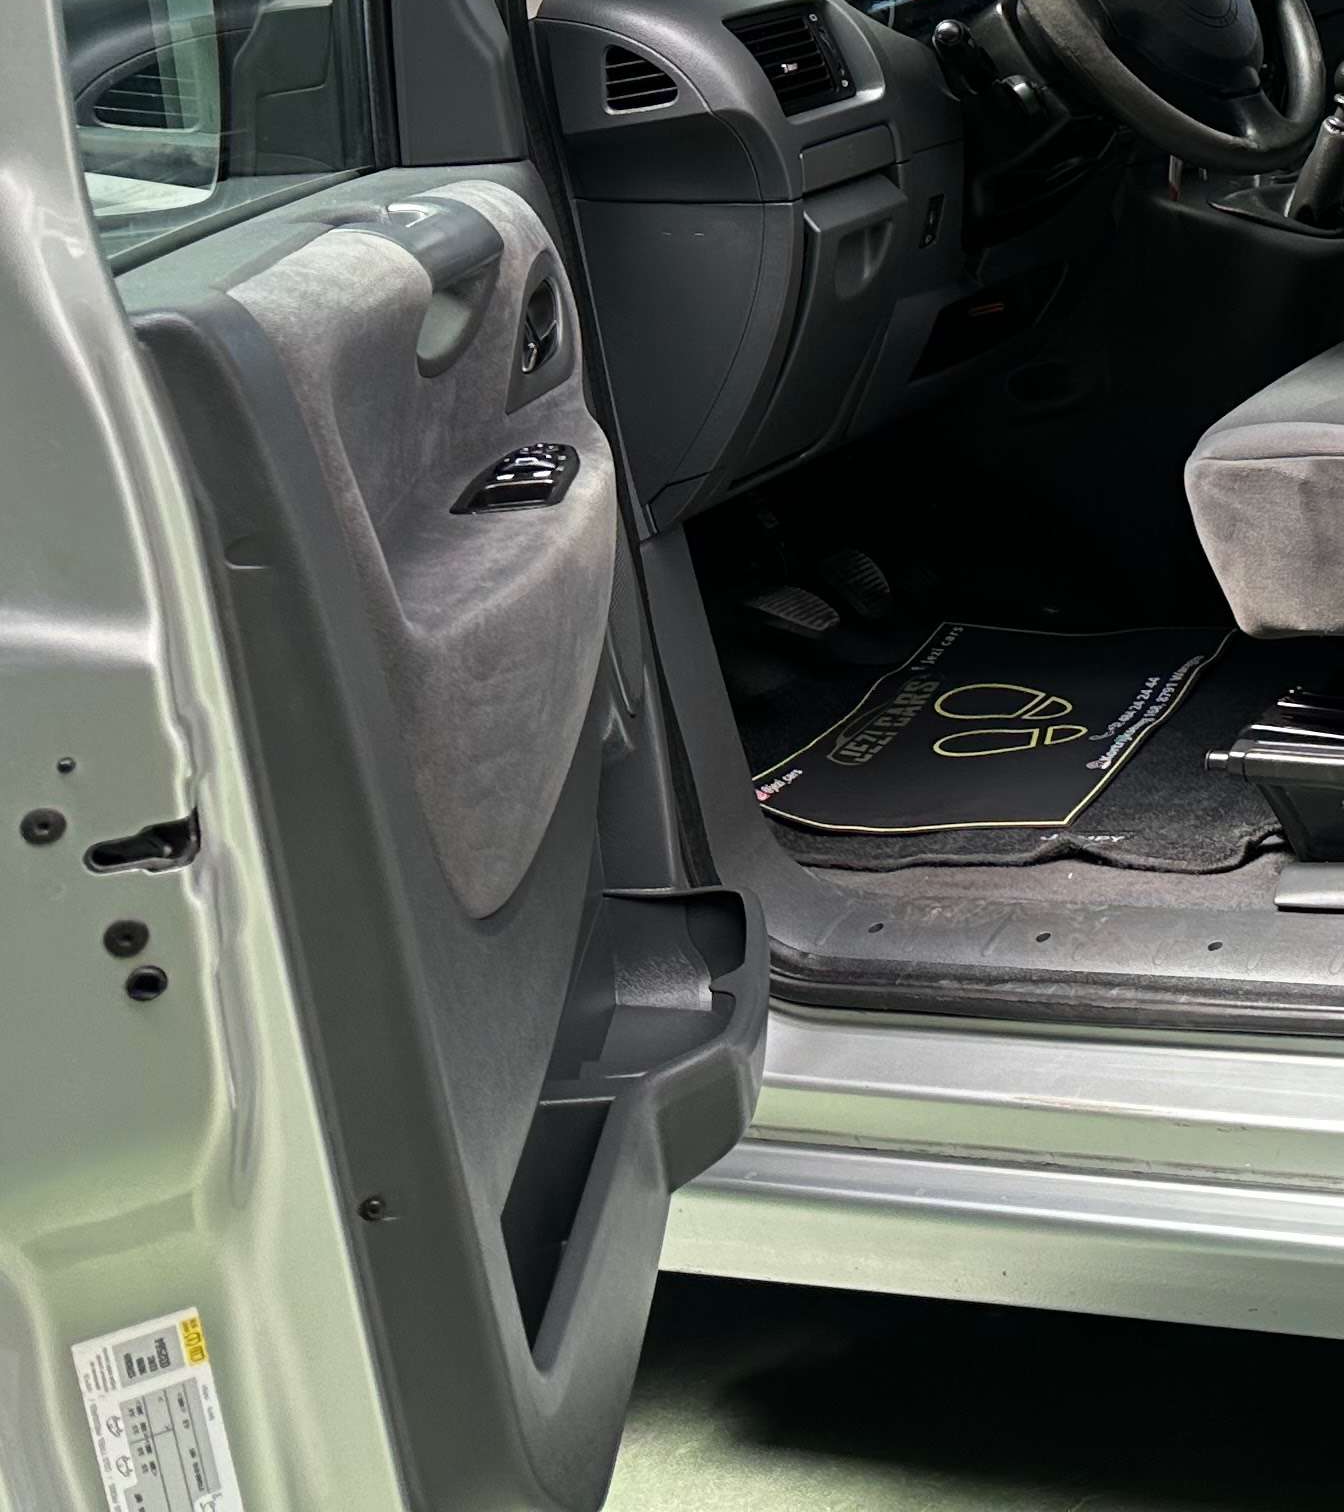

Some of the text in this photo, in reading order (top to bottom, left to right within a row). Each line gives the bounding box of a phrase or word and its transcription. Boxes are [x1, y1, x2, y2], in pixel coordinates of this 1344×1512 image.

[1136, 689, 1152, 701] 24
[1145, 677, 1161, 689] 44
[838, 678, 941, 763] JEZI CARS
